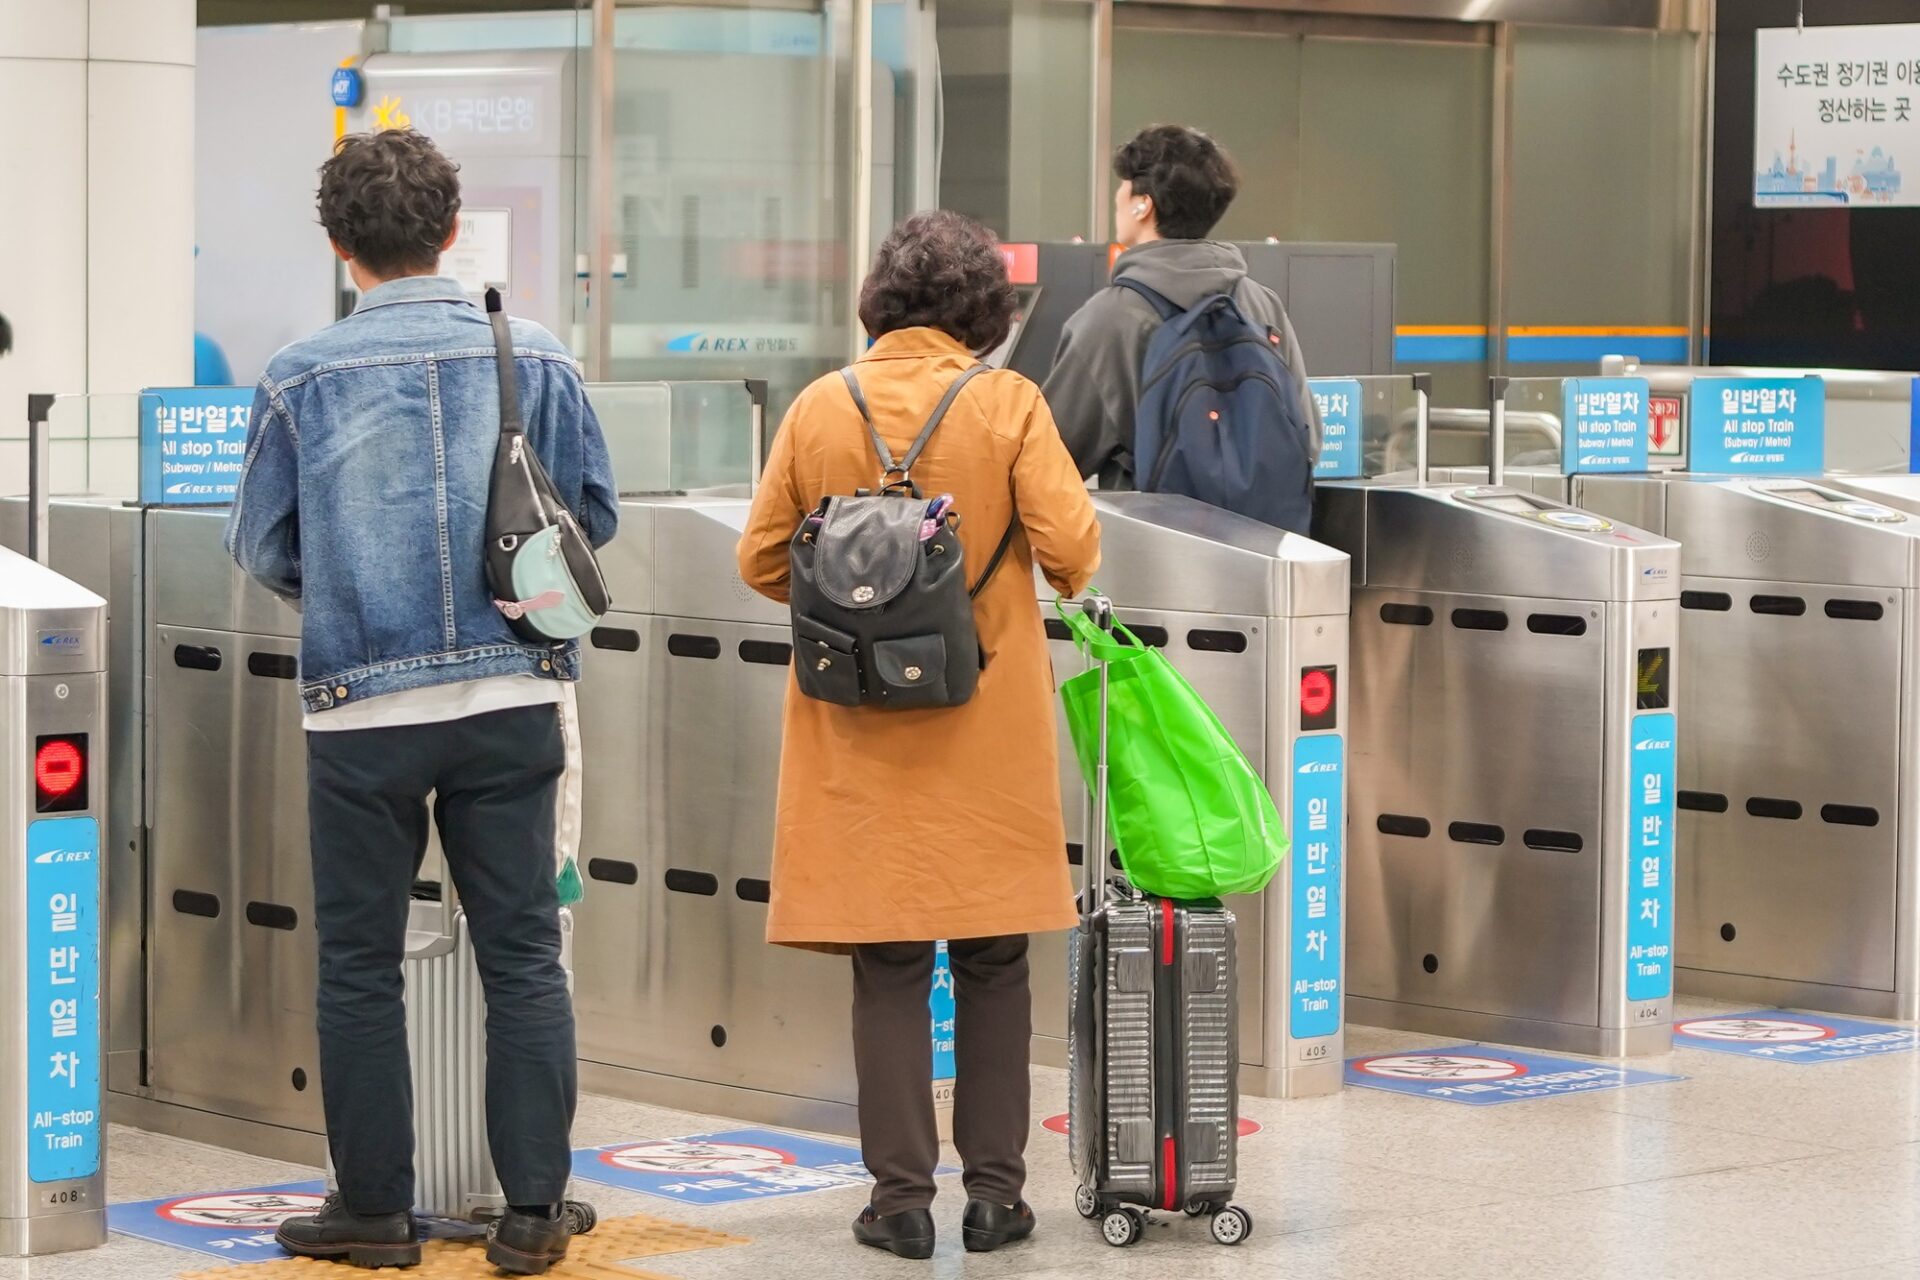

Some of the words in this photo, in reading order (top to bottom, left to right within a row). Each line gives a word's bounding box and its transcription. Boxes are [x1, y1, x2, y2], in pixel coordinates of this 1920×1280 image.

[1777, 62, 1829, 88] 수도권
[1837, 60, 1888, 87] 정기권
[1818, 97, 1887, 123] 정산하는
[1894, 96, 1911, 122] 곳
[1313, 392, 1349, 417] 열차
[1575, 392, 1640, 416] 일반열차
[1722, 388, 1797, 414] 일반열차
[156, 405, 252, 434] 일반열차
[1590, 420, 1612, 435] stop
[1613, 419, 1637, 433] Train
[1723, 419, 1738, 433] All
[1741, 419, 1766, 435] stop
[1768, 418, 1794, 433] Train
[181, 440, 213, 457] stop
[1323, 440, 1343, 452] etro)
[1724, 436, 1758, 449] (Subway
[1764, 435, 1792, 448] Metro)
[213, 461, 243, 473] Metro
[1640, 773, 1662, 928] 일반열차
[1306, 798, 1329, 961] 일반열차
[1630, 944, 1669, 959] All-stop
[1637, 962, 1661, 976] Train
[50, 893, 80, 1088] 일반열차
[1295, 979, 1337, 994] All-stop
[1302, 997, 1329, 1012] Train
[1640, 1008, 1658, 1018] 404
[1306, 1045, 1327, 1057] 405
[34, 1110, 94, 1128] All-stop
[45, 1133, 82, 1150] Train
[50, 1191, 78, 1204] 408
